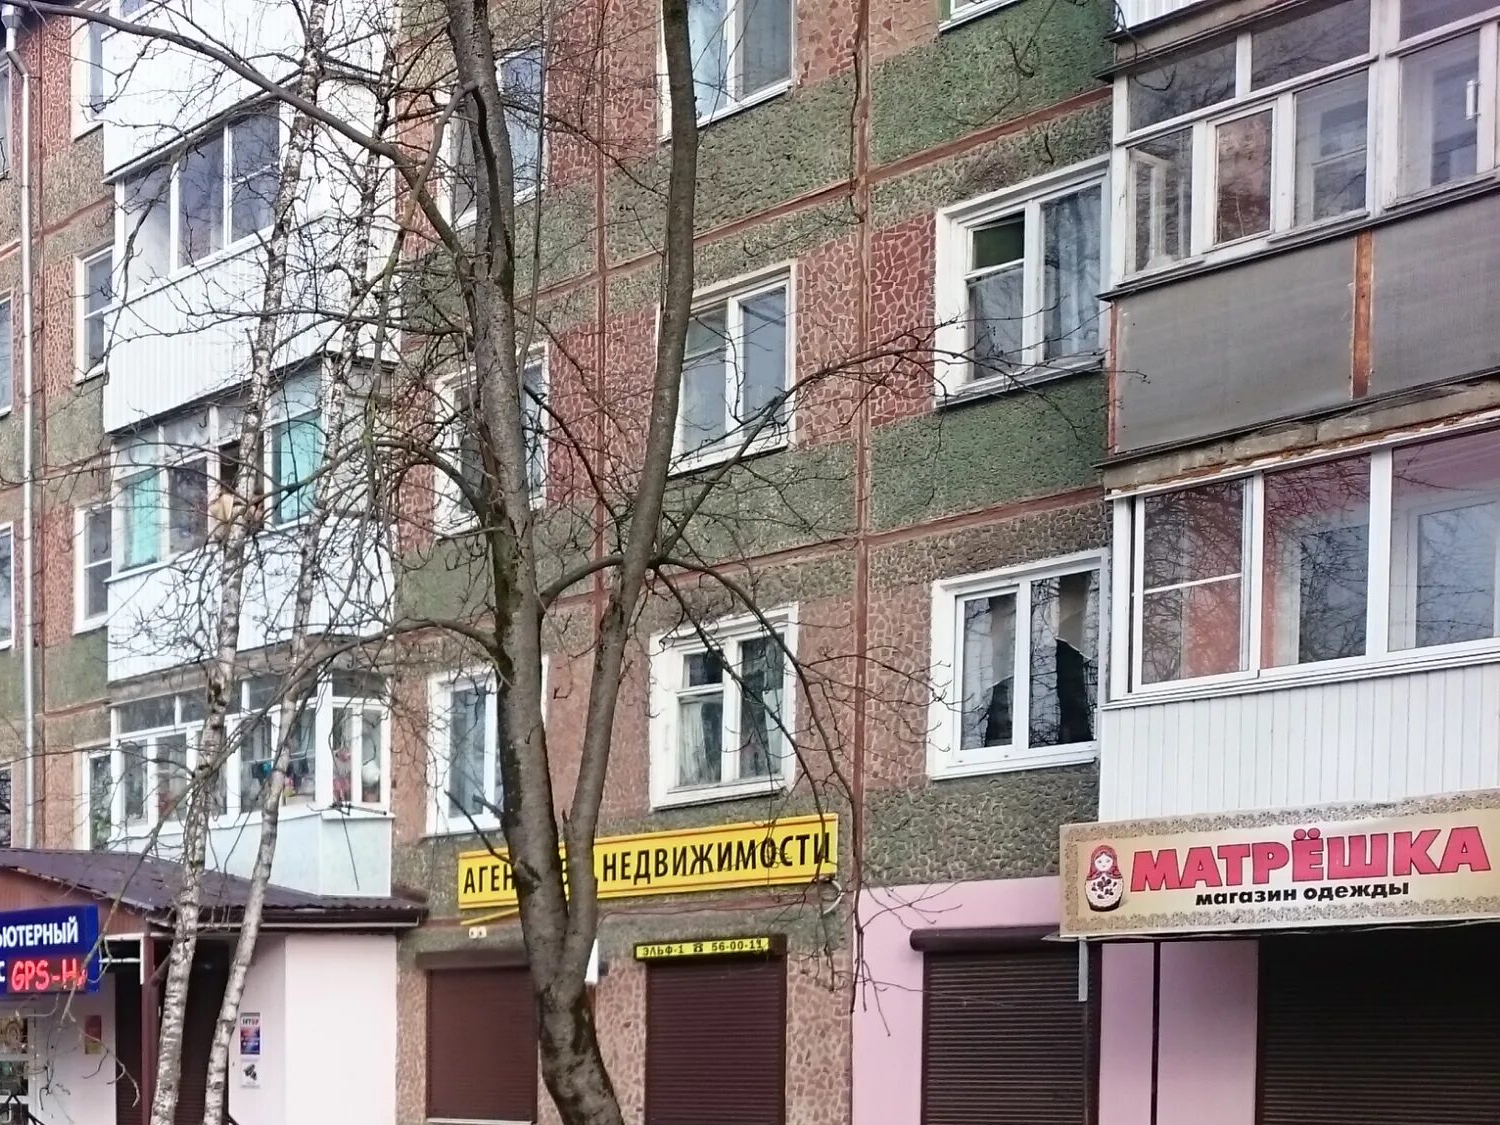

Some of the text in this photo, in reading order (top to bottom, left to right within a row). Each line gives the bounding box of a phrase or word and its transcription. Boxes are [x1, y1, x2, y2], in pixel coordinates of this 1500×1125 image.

[602, 832, 831, 885] НЕДВИЖИМОСТИ
[1130, 827, 1491, 892] МАТРЁШКА
[1195, 881, 1409, 906] магазин одежды
